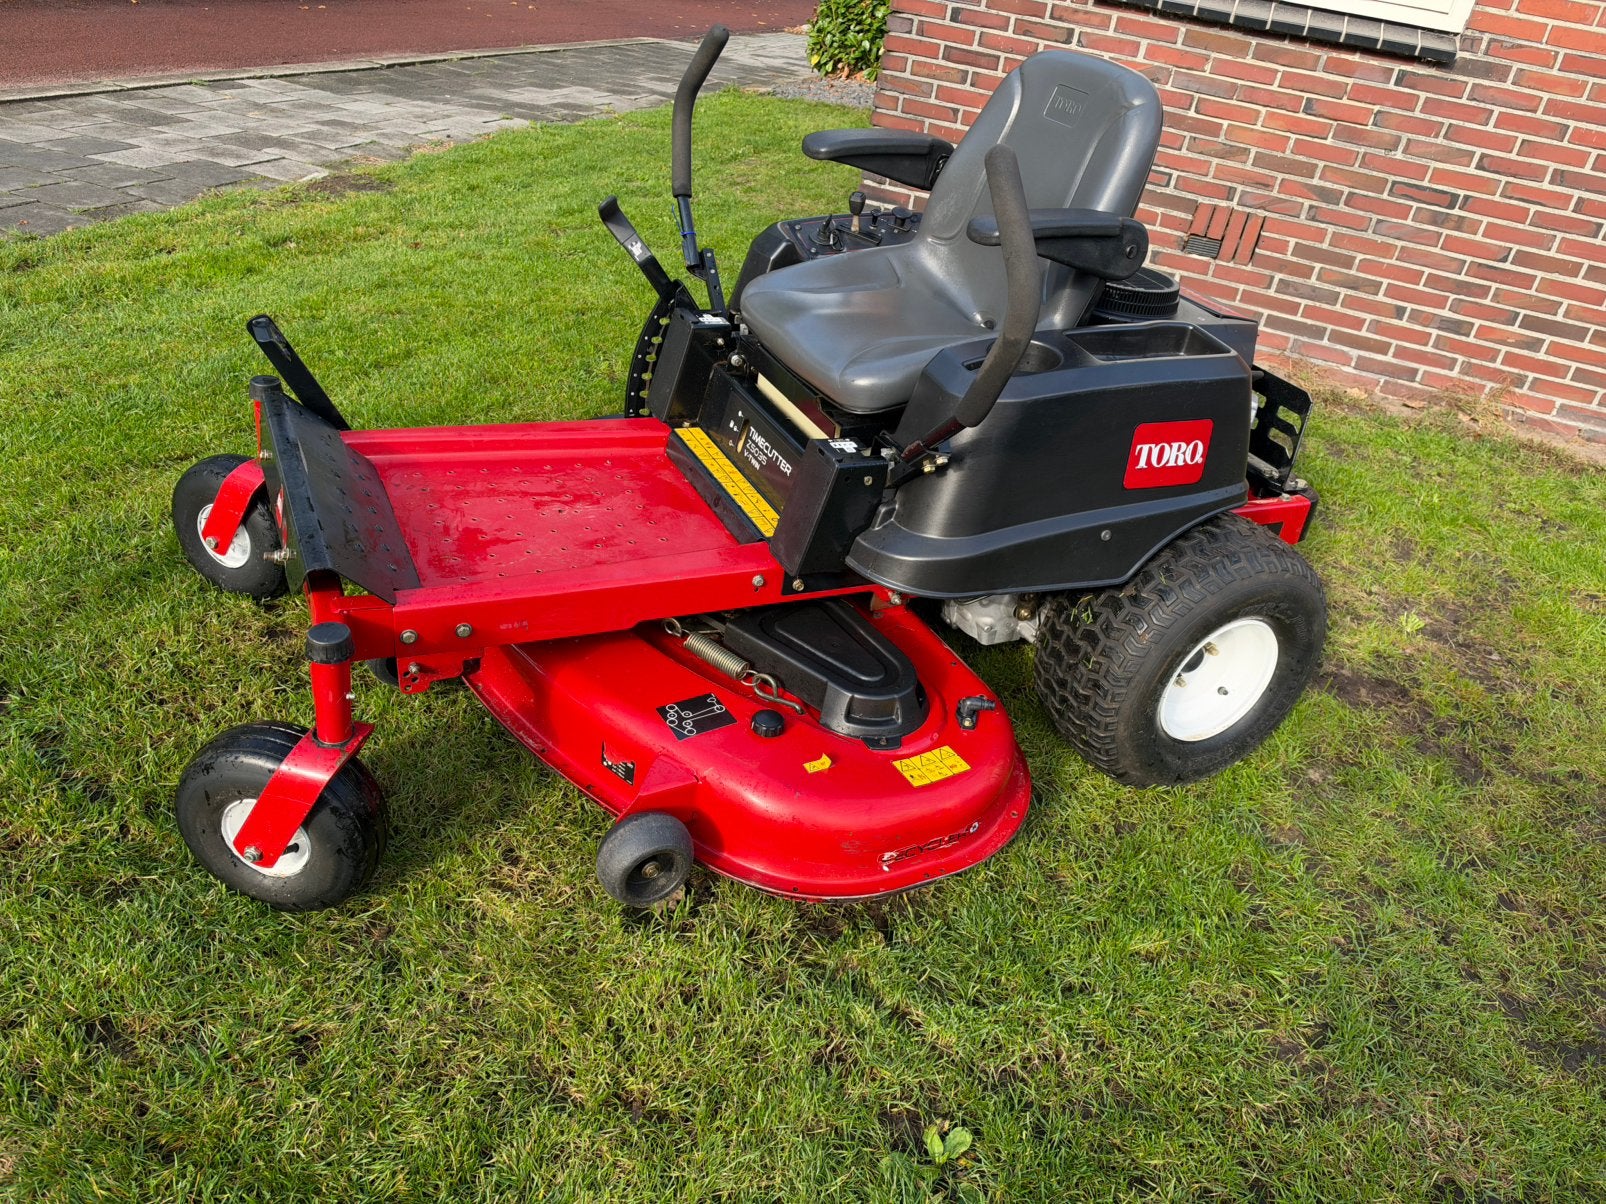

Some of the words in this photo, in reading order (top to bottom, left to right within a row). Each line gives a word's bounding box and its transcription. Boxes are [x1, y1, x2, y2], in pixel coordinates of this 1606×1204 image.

[744, 449, 760, 471] V-TWIN
[746, 439, 768, 466] Z5035
[749, 426, 792, 476] TIMECUTTER
[1135, 440, 1204, 469] TORO
